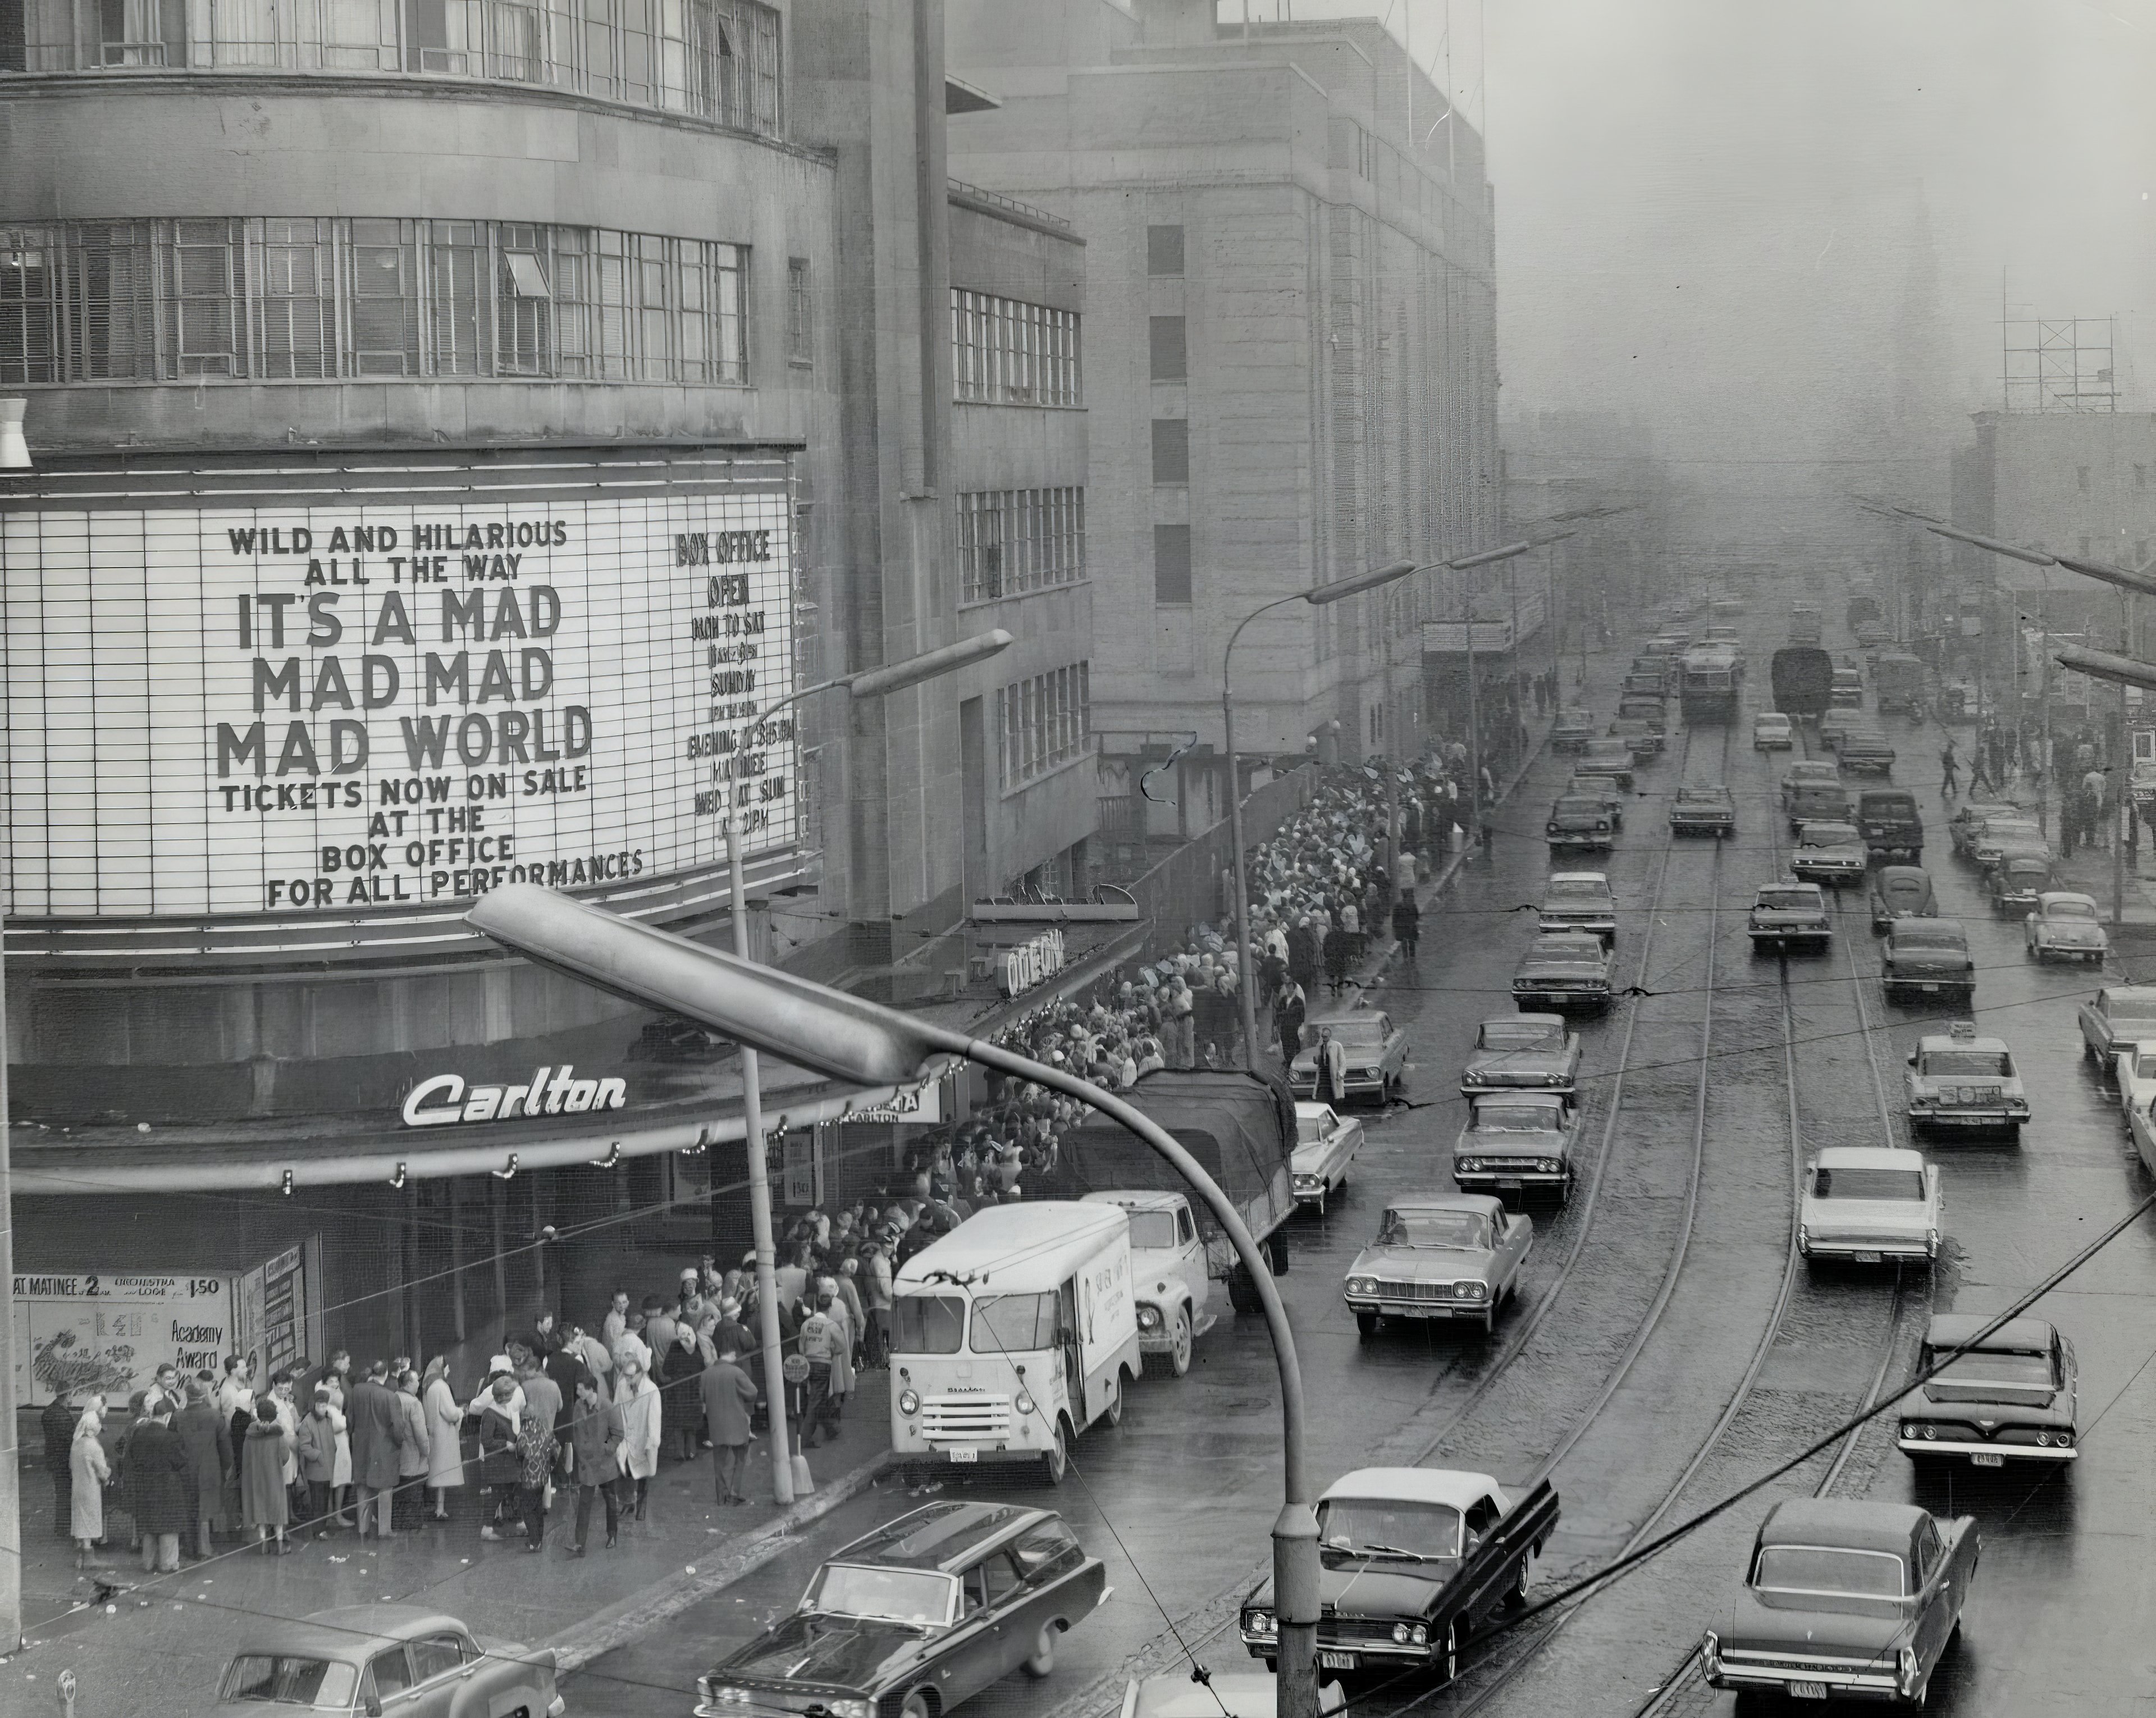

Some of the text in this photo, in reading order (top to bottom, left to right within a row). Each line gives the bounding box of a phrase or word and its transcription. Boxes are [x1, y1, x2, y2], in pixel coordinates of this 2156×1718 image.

[228, 520, 567, 555] WILD AND HILARIOUS
[304, 553, 522, 586] ALL THE WAY
[239, 586, 561, 649] IT'S A MAD
[253, 647, 552, 712] MAD MAD
[217, 705, 592, 778] MAD WORLD
[218, 765, 587, 812] TICKETS NOW ON SALE
[369, 805, 485, 838] AT THE
[322, 834, 513, 872] BOX OFFICE
[268, 849, 643, 907] FOR ALL PERFORMANCES
[401, 1065, 627, 1126] Carlton
[30, 1277, 78, 1295] MATINEE
[171, 1319, 223, 1345] Academy
[176, 1347, 217, 1369] Award
